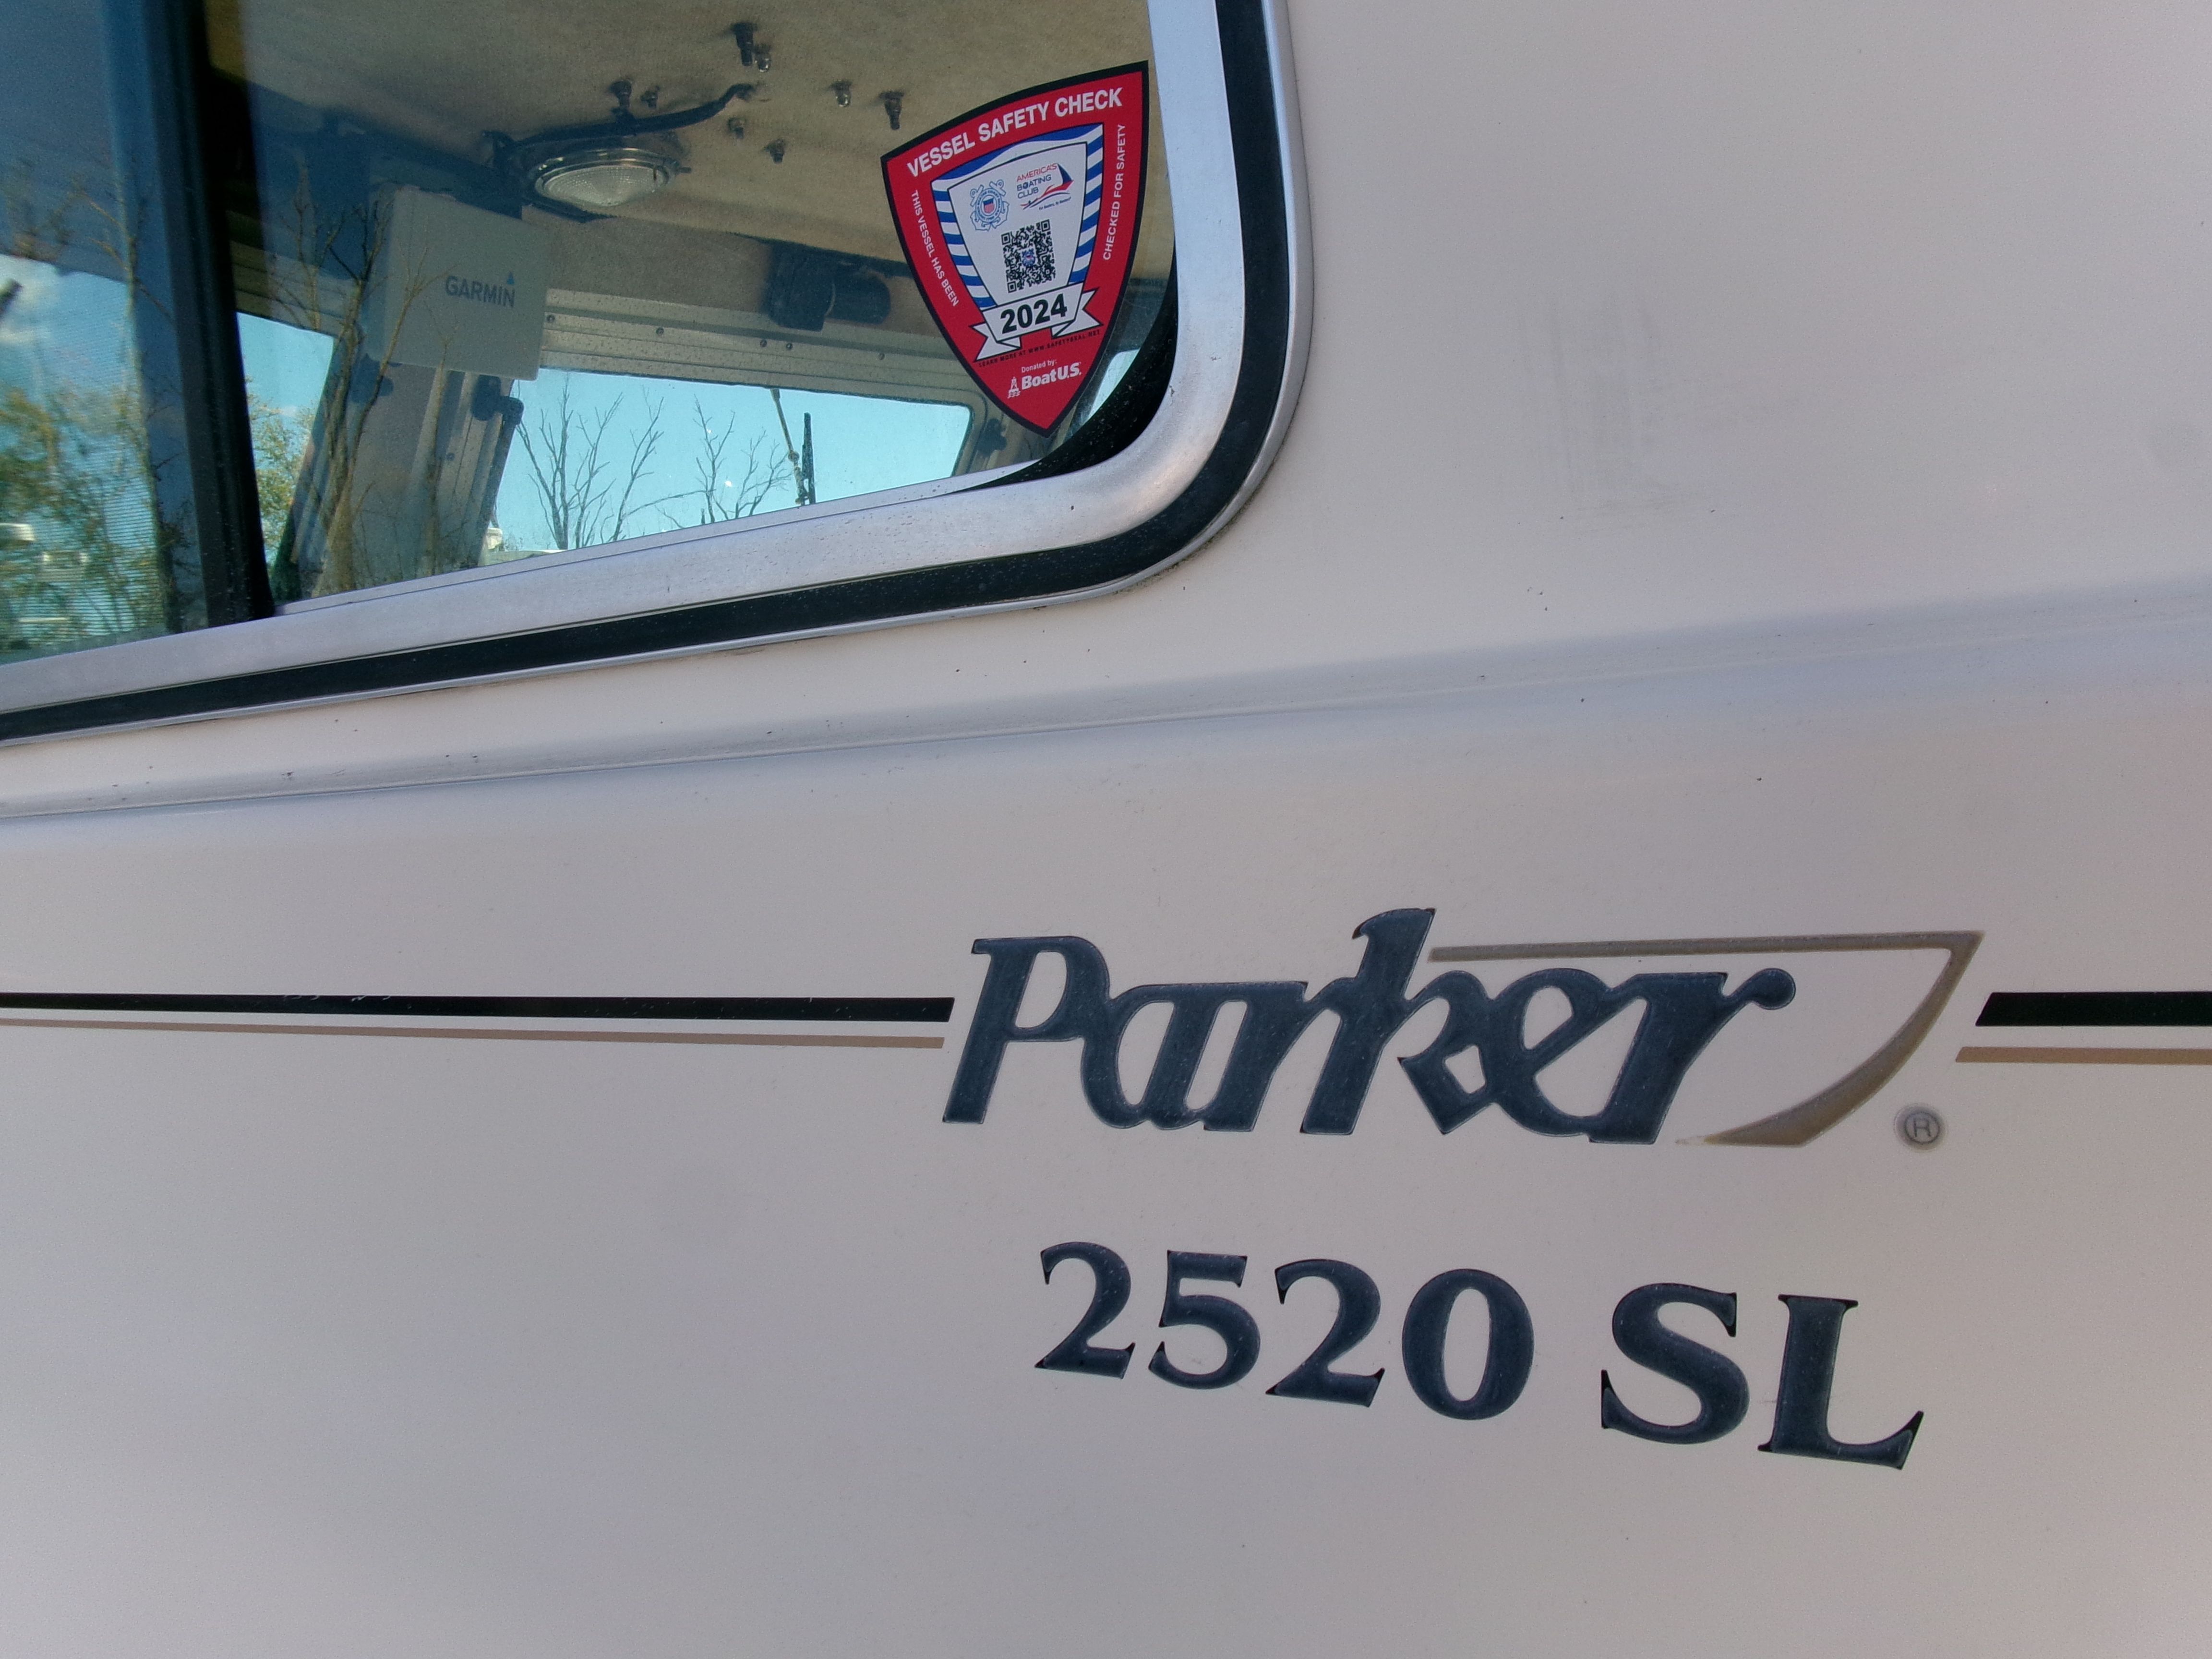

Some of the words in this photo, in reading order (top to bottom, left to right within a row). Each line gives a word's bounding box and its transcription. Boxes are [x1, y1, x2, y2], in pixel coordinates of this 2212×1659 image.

[907, 132, 975, 177] VESSEL
[978, 101, 1049, 142] SAFETY
[1055, 87, 1123, 117] CHECK
[1116, 124, 1126, 170] SAFETY
[1016, 163, 1057, 182] AMERICA'S
[1017, 174, 1052, 191] BOATING
[1018, 187, 1039, 199] CLUB
[1114, 173, 1124, 198] FOR
[912, 190, 923, 216] THIS
[918, 216, 935, 258] VESSEL
[931, 257, 945, 279] HAS
[941, 279, 959, 307] BEEN
[1103, 201, 1120, 260] CHECKED
[445, 275, 516, 307] GARMIN
[1000, 293, 1067, 335] 2024
[1021, 361, 1046, 373] Donated
[942, 908, 1796, 1145] Parker
[1034, 1242, 1534, 1420] 2520
[1600, 1283, 1924, 1470] SL
